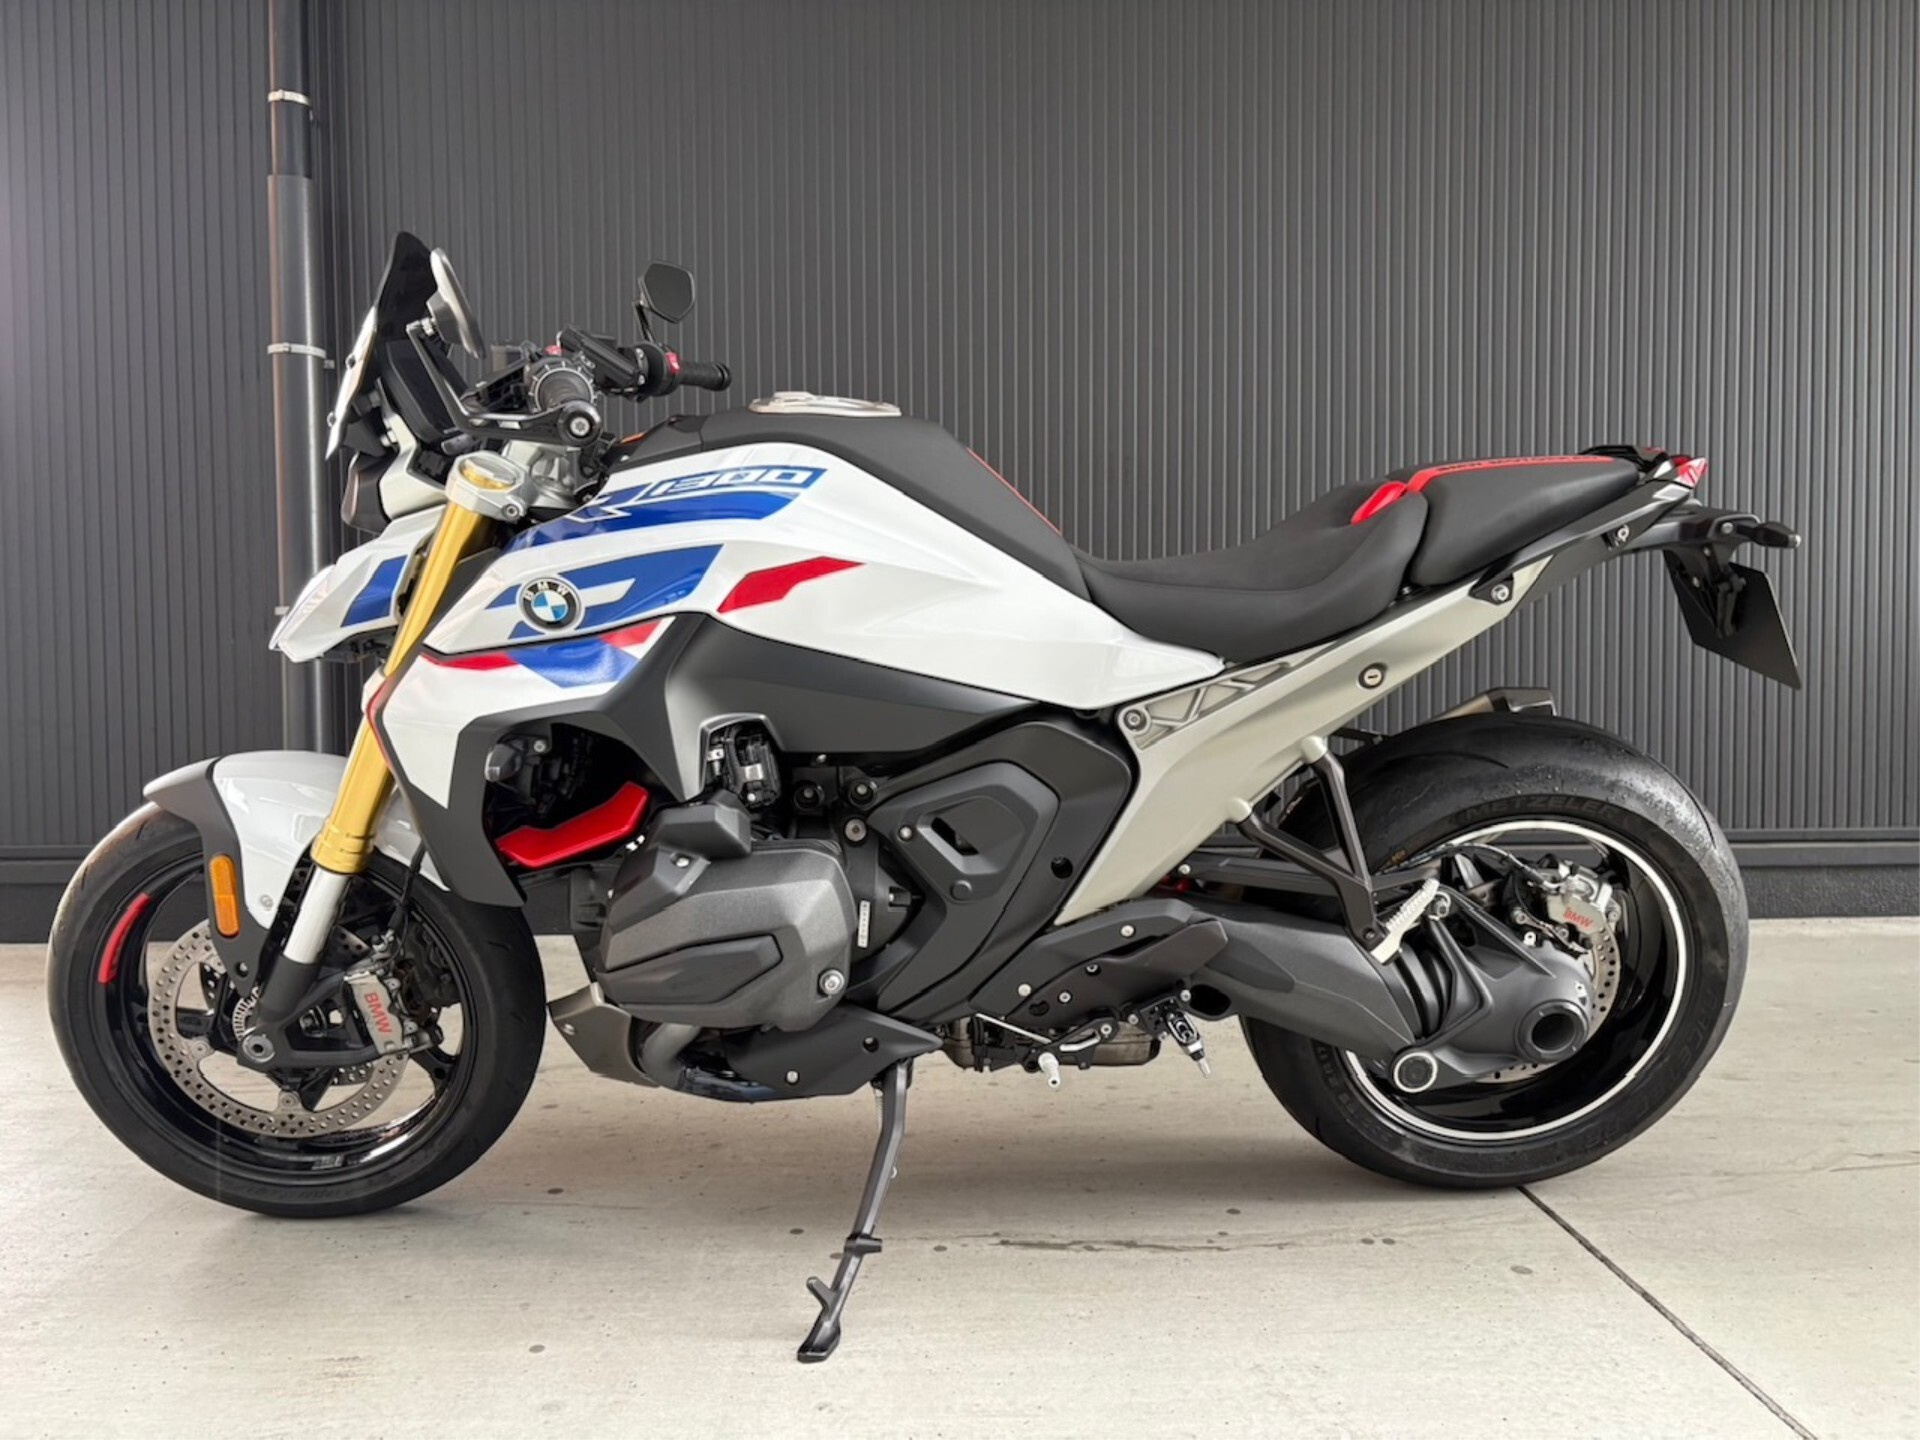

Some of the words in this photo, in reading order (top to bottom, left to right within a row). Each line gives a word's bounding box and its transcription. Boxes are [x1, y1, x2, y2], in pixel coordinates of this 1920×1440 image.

[648, 468, 814, 497] 1300
[523, 581, 570, 601] BMW
[1563, 908, 1594, 928] BMW
[365, 992, 393, 1033] BMW
